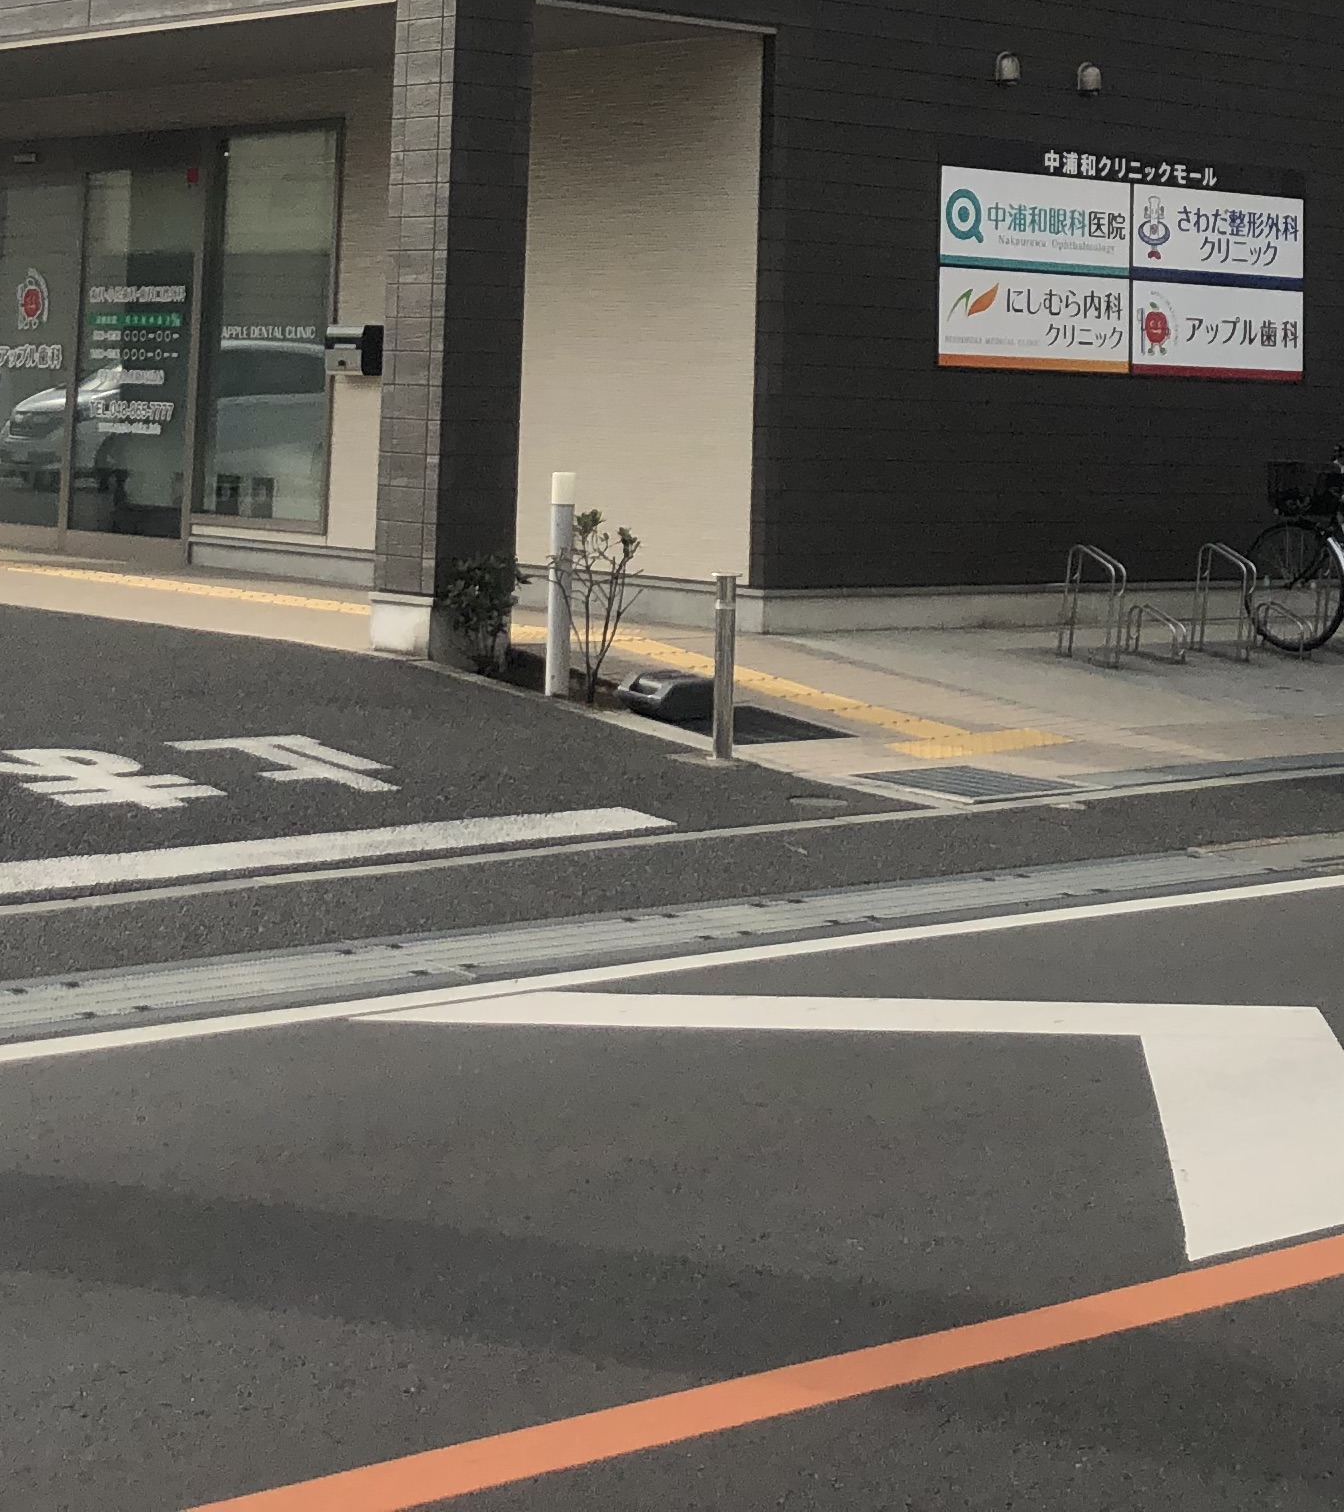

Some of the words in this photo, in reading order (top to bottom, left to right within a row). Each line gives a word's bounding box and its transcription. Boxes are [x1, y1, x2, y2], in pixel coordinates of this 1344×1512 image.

[1045, 150, 1218, 186] 中浦和クリニックモール
[987, 202, 1126, 240] 中浦和眼科医院
[1177, 206, 1299, 242] さわだ整形外科
[1200, 236, 1277, 267] クリニック
[1006, 288, 1123, 321] にしむら内科
[221, 326, 248, 338] APPLE
[250, 326, 283, 339] DENTAL
[285, 326, 316, 339] CLINIC
[1045, 324, 1123, 349] クリニック
[1186, 317, 1298, 349] アップル歯科
